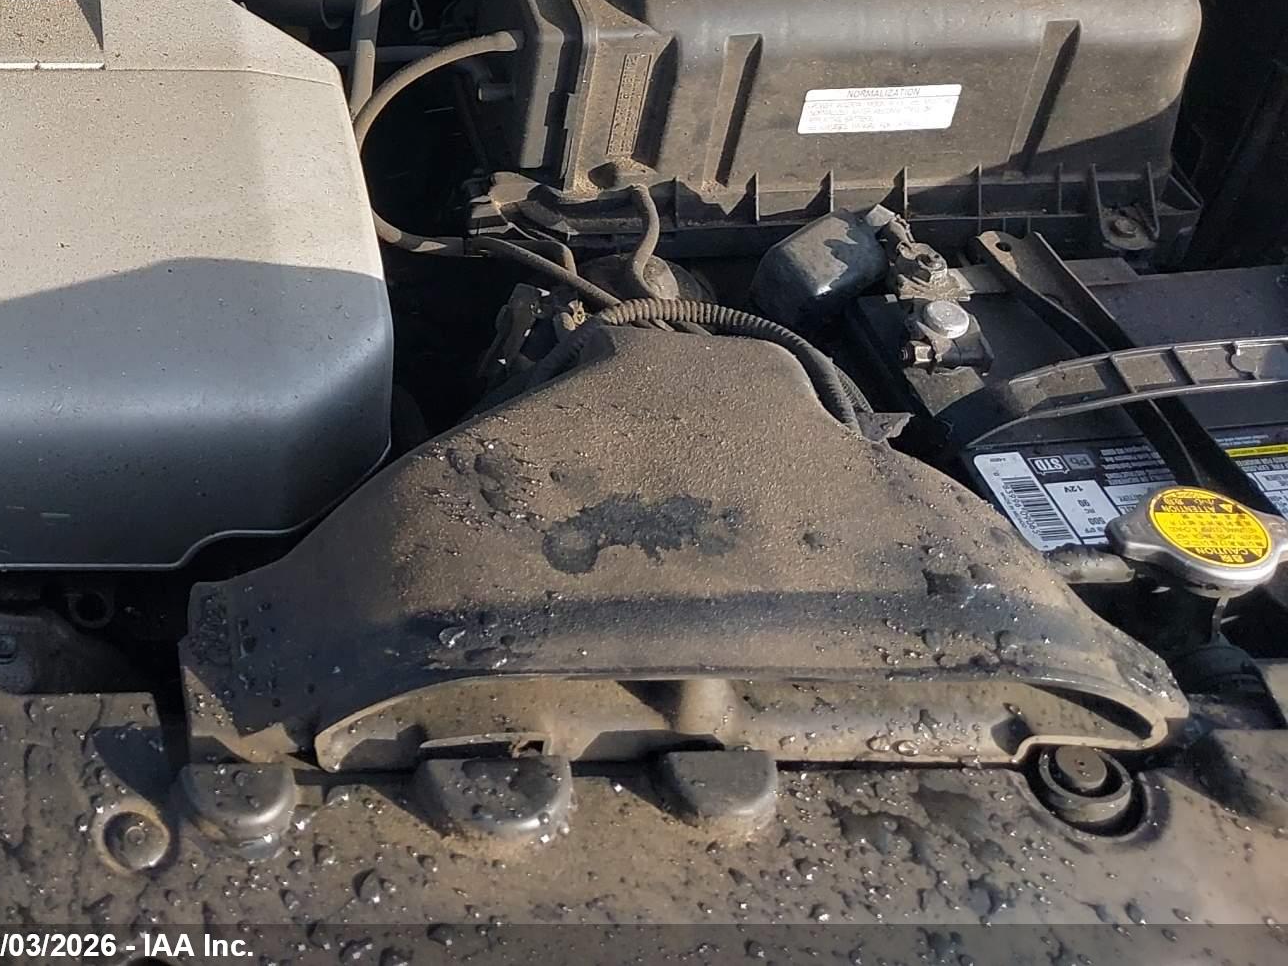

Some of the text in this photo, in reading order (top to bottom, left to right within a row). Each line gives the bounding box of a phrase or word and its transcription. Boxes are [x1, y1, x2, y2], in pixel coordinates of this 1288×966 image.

[847, 88, 920, 98] NORMALIZATION
[1033, 458, 1064, 472] STD
[1068, 456, 1091, 467] Pb
[1064, 484, 1083, 493] 12V
[1077, 499, 1091, 508] 90
[1160, 504, 1216, 514] ATTENTION
[1195, 547, 1249, 556] CAUTION
